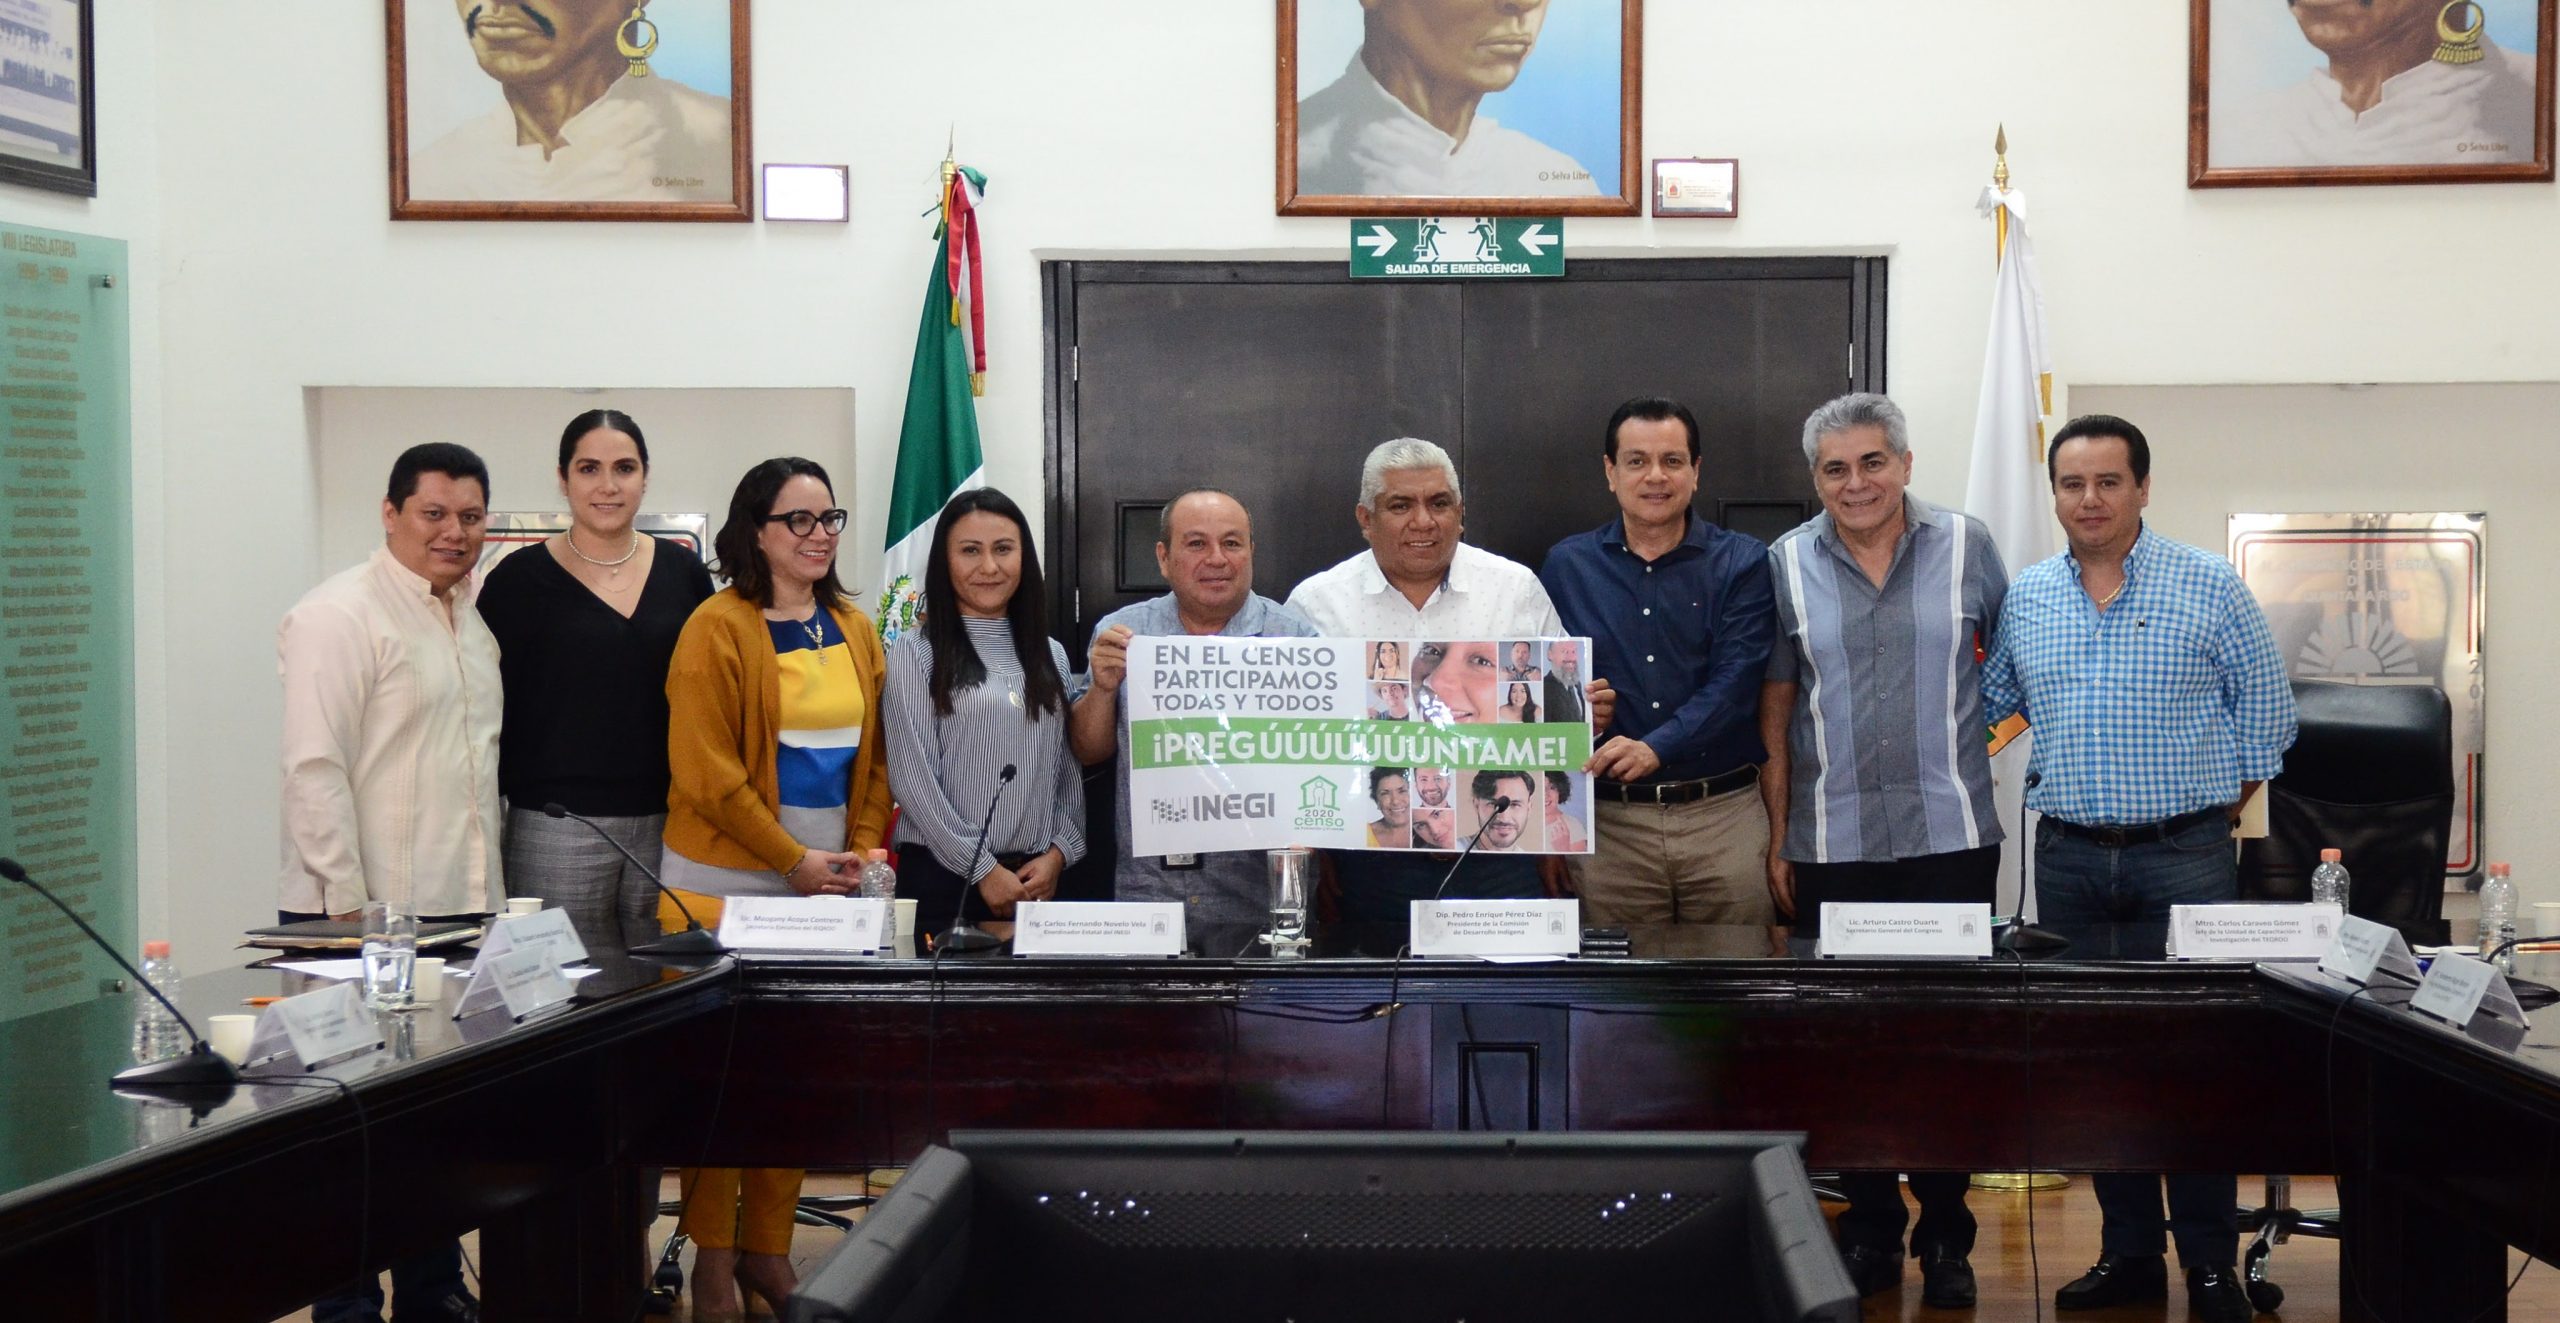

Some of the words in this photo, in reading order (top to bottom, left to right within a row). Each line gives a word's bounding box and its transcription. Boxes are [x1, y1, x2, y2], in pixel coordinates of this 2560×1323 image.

[1551, 171, 1571, 180] Selva
[1573, 171, 1590, 180] Libre
[19, 234, 77, 258] LEGISLATURA
[1385, 264, 1429, 274] SALIDA
[1431, 264, 1448, 274] DE
[1450, 263, 1531, 274] EMERGENCIA
[1155, 645, 1190, 665] EN
[1203, 646, 1231, 665] EL
[1241, 646, 1336, 667] CENSO
[1154, 670, 1338, 690] PARTICIPAMOS
[1152, 694, 1226, 711] TODAS
[1233, 694, 1247, 710] Y
[1255, 694, 1334, 711] TODOS
[1193, 793, 1275, 822] INEGI
[1304, 809, 1334, 817] 2020
[1294, 817, 1345, 827] censo
[1436, 911, 1451, 919] Dip.
[1475, 911, 1503, 919] Enrique
